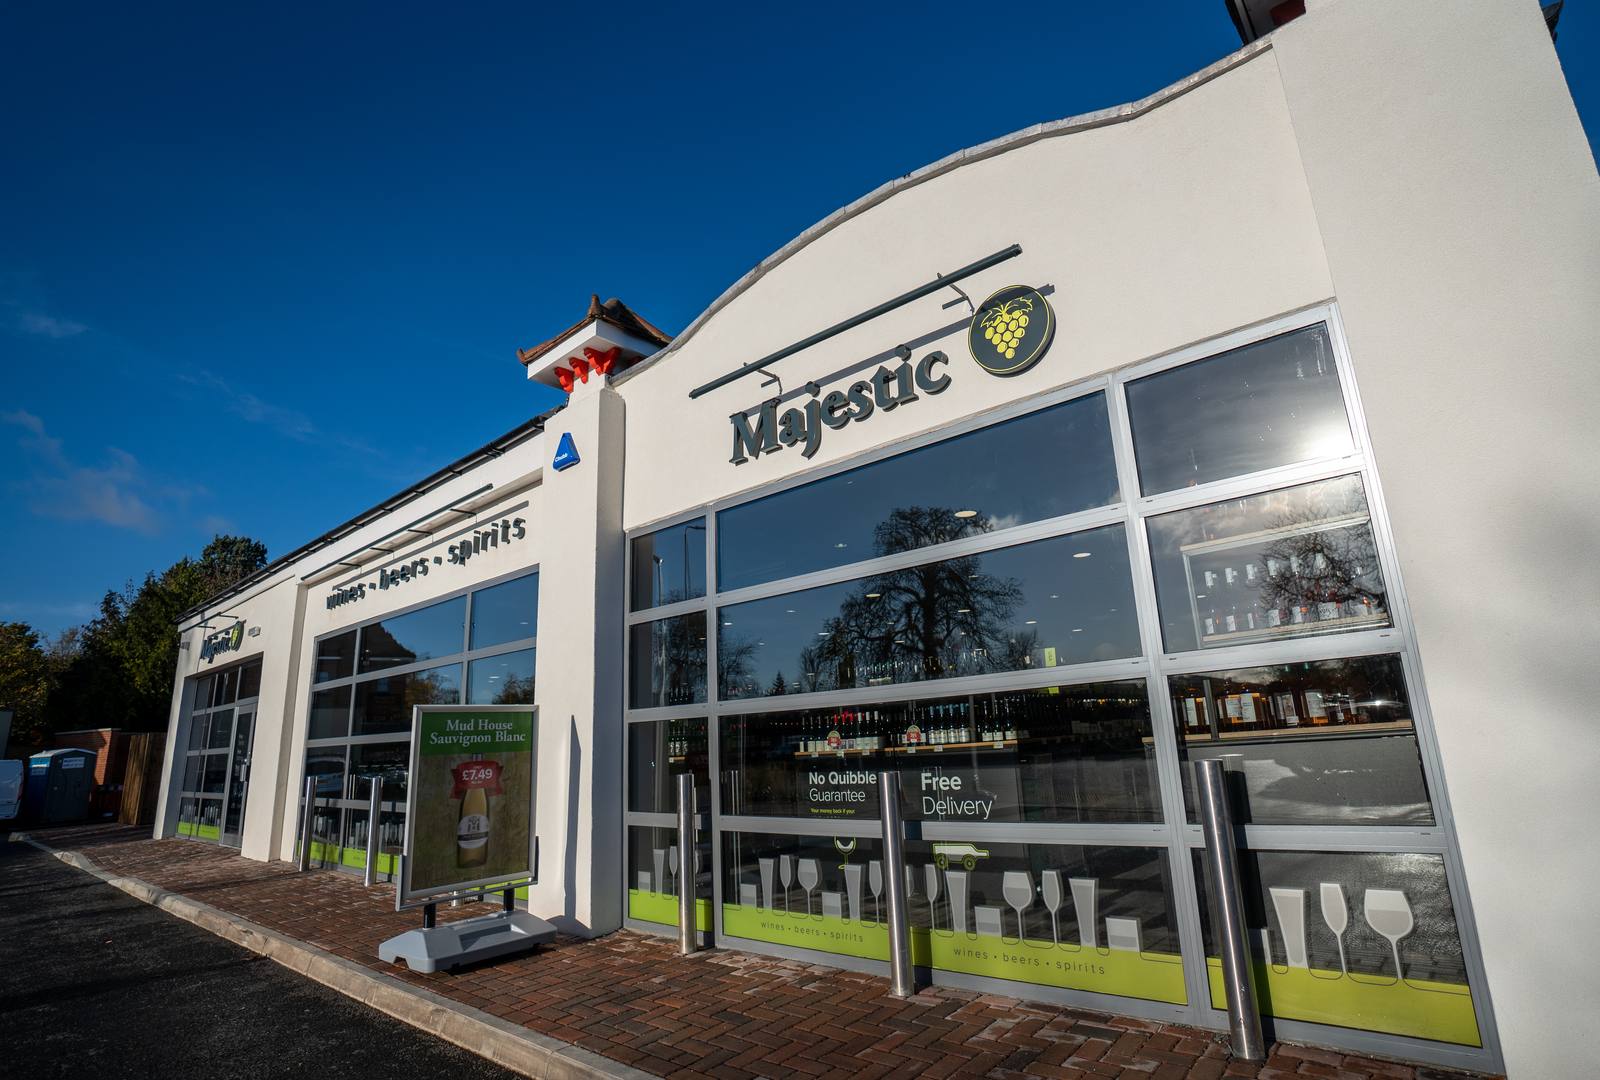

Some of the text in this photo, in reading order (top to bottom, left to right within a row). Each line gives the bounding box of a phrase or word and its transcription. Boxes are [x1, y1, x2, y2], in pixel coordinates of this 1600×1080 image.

[729, 344, 952, 466] Majestic
[379, 557, 429, 591] beers
[447, 517, 526, 567] spirits
[446, 719, 513, 732] Mud House
[430, 731, 526, 746] Sauvignon Blanc
[462, 768, 493, 781] £7.49
[808, 770, 877, 785] No Quibble
[920, 772, 962, 791] Free
[809, 788, 866, 802] Guarantee
[922, 796, 993, 820] Delivery
[761, 921, 864, 943] wines beers spirits
[953, 948, 1105, 975] wines beers spirits
